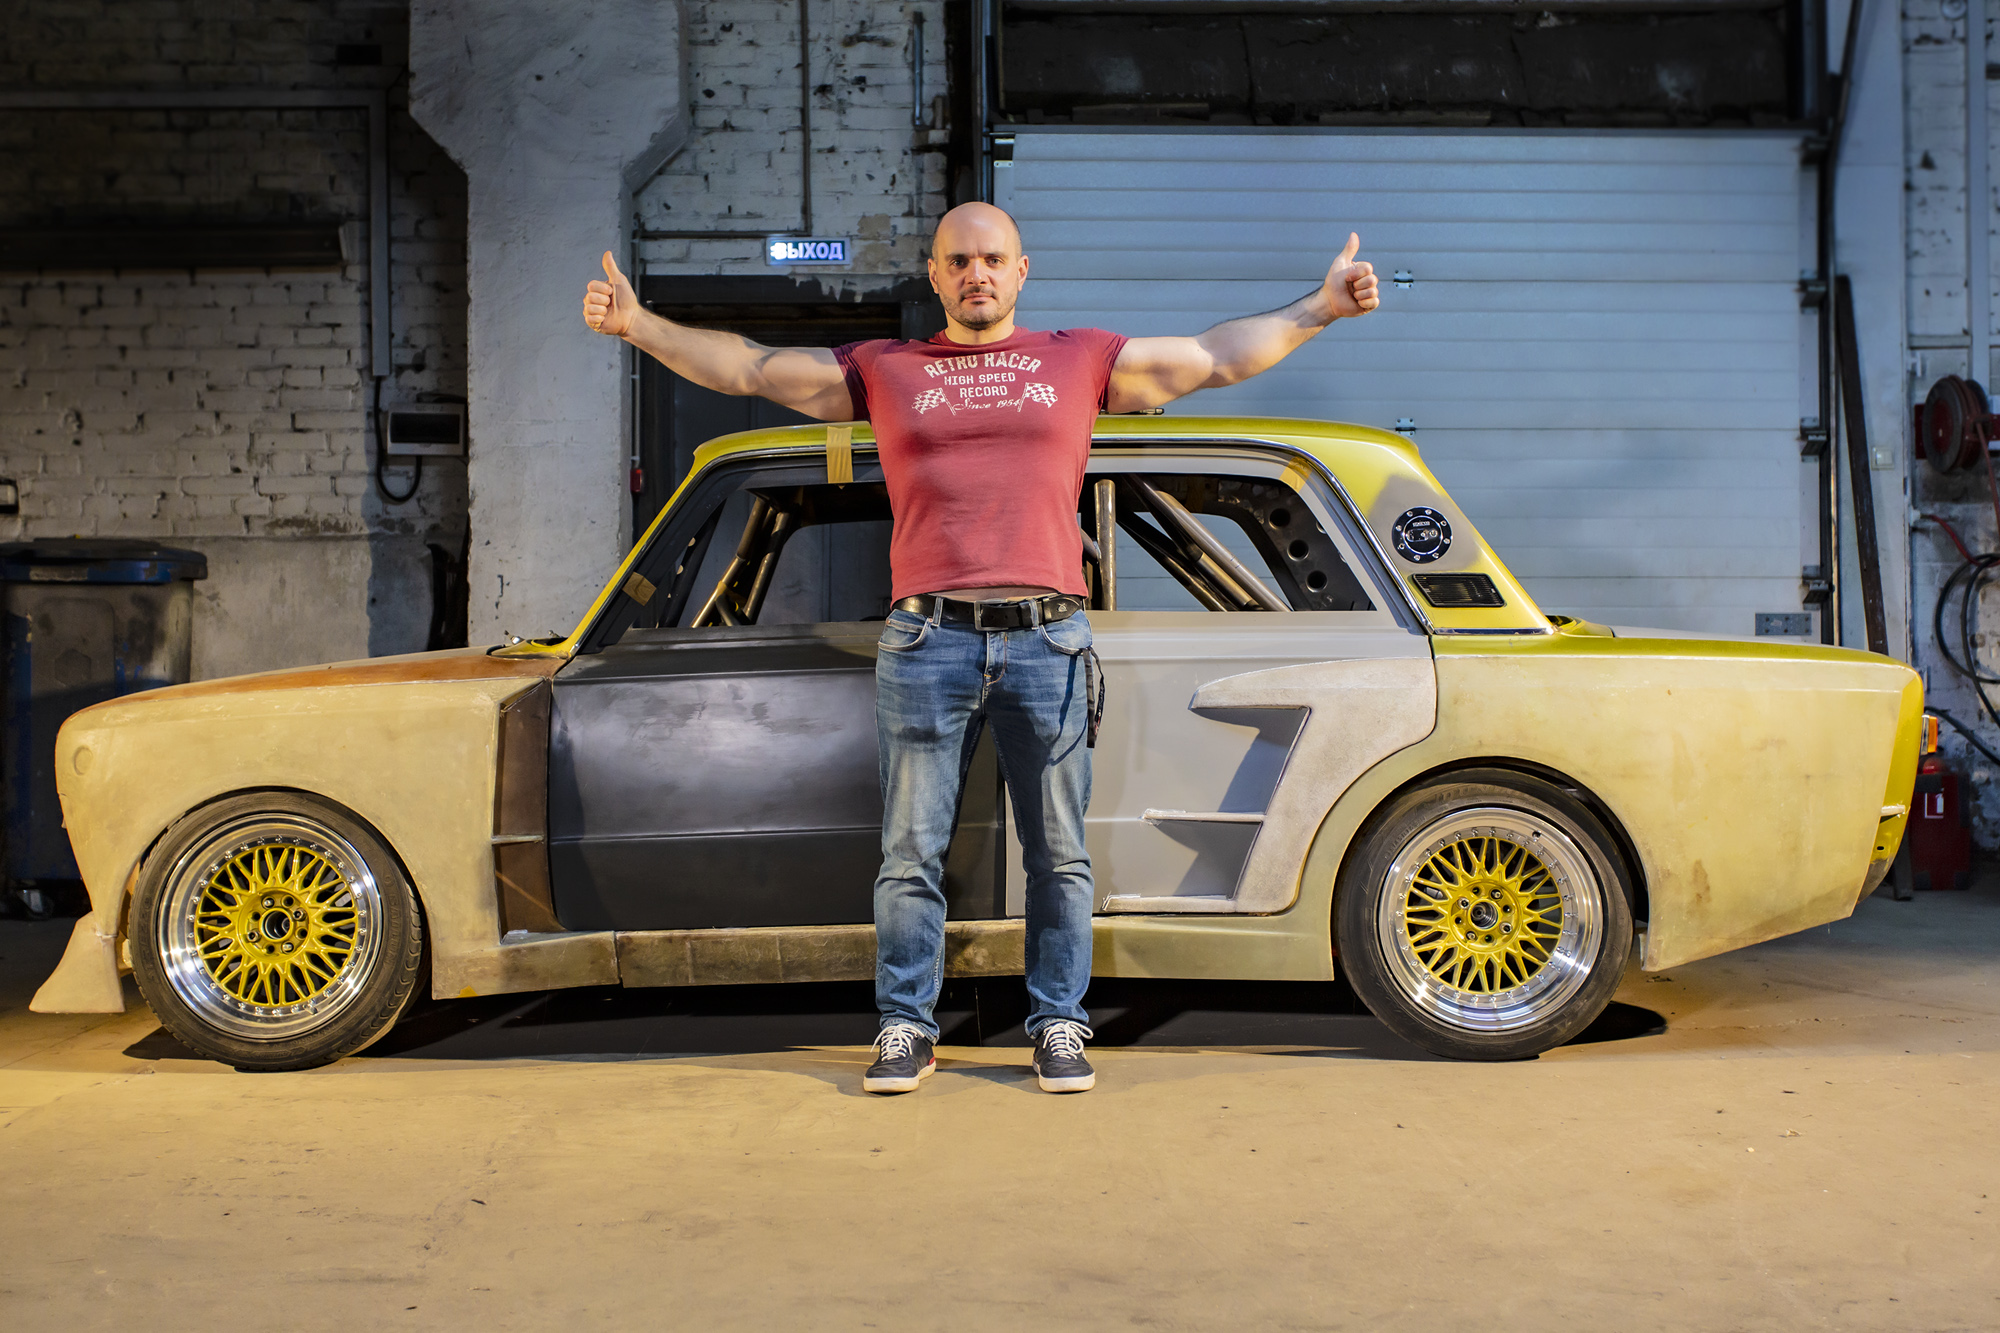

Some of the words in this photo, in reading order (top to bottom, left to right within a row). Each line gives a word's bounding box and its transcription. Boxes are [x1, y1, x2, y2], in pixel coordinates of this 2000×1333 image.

[923, 355, 978, 378] RETRO
[984, 352, 1042, 373] RACER
[944, 375, 974, 386] HIGH
[978, 372, 1016, 384] SPEED
[959, 385, 1008, 399] RECORD
[952, 397, 992, 411] Since
[996, 398, 1021, 409] 1954
